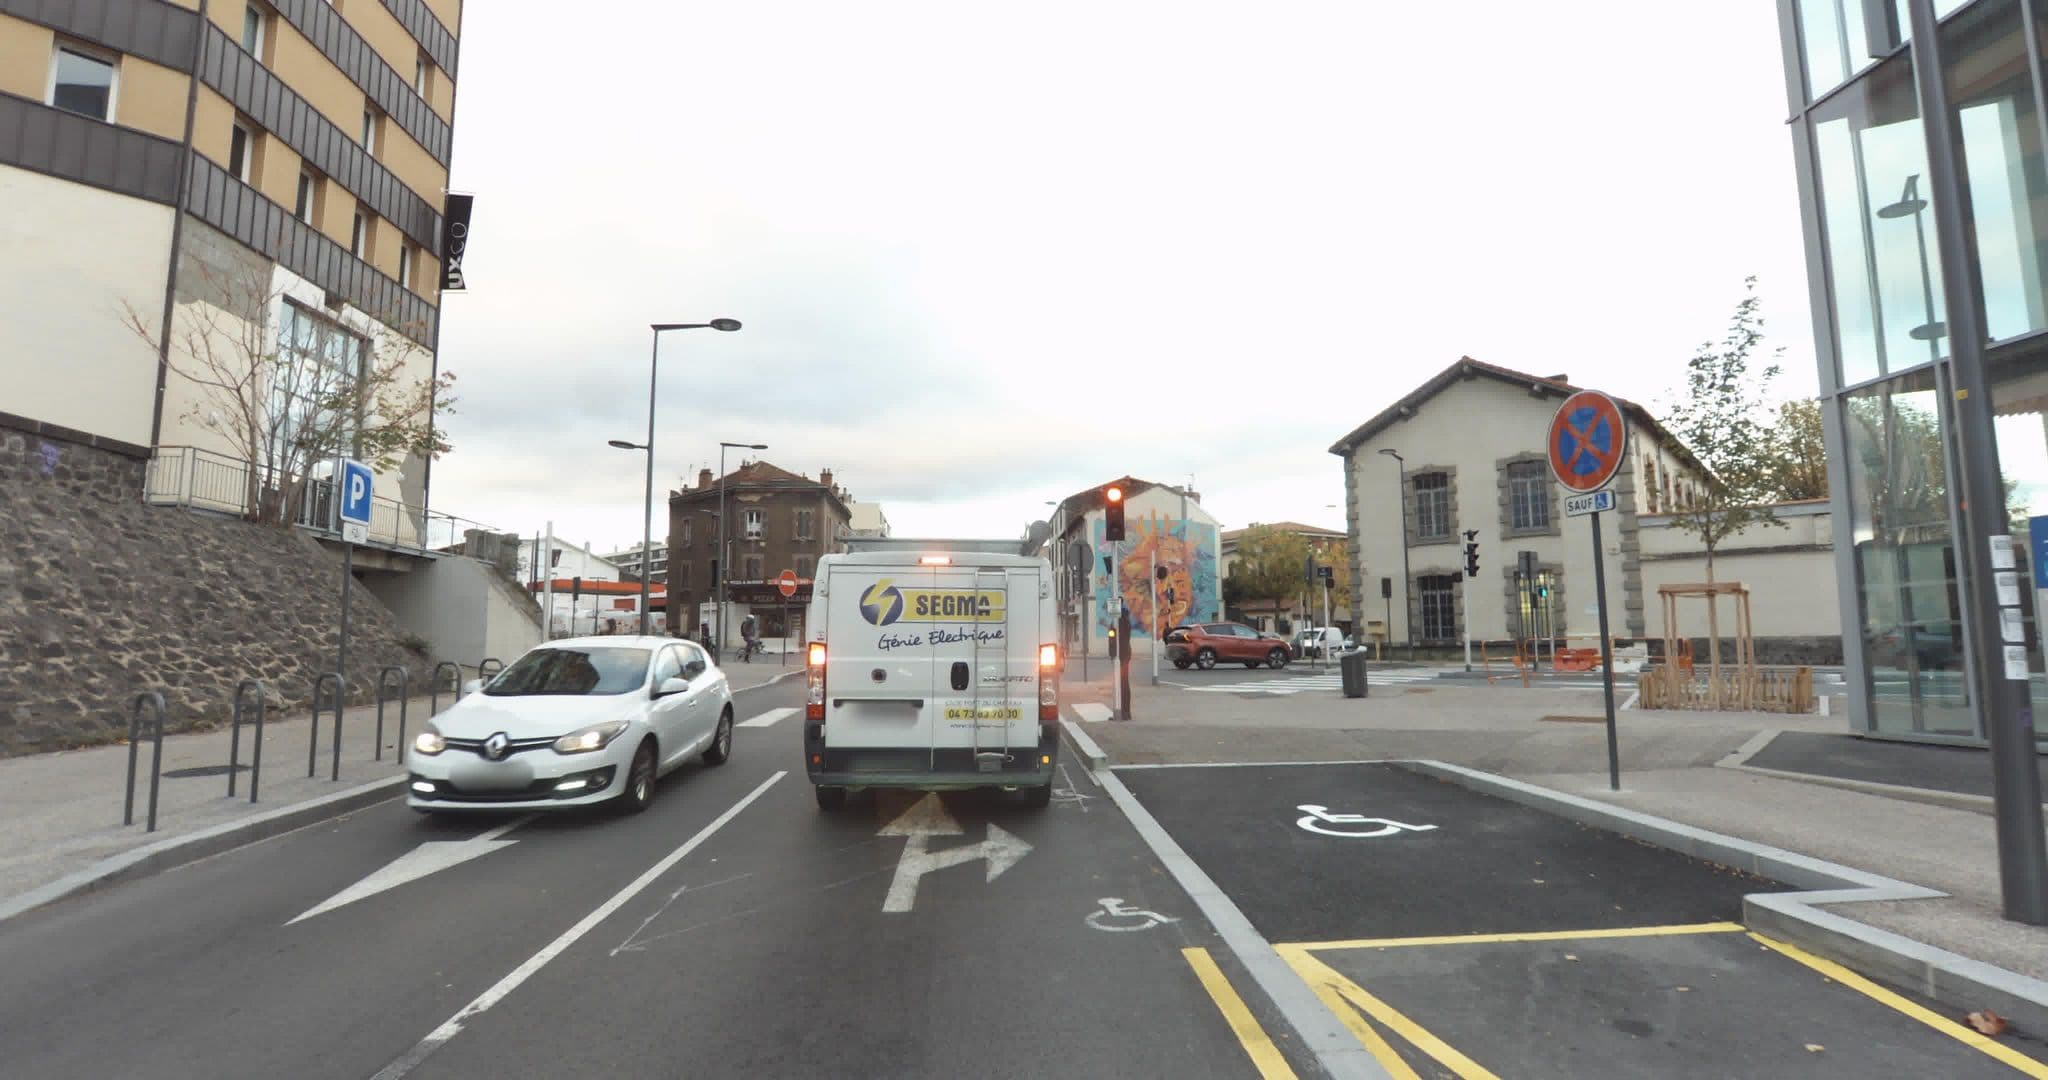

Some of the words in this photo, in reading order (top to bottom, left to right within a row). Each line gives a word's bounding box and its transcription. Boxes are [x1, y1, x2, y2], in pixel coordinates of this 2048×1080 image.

[350, 473, 365, 510] P
[1567, 498, 1593, 512] SAUF
[916, 595, 991, 616] SEGMA
[878, 633, 922, 651] Génie
[928, 627, 1004, 645] Electrique
[948, 709, 960, 718] 04
